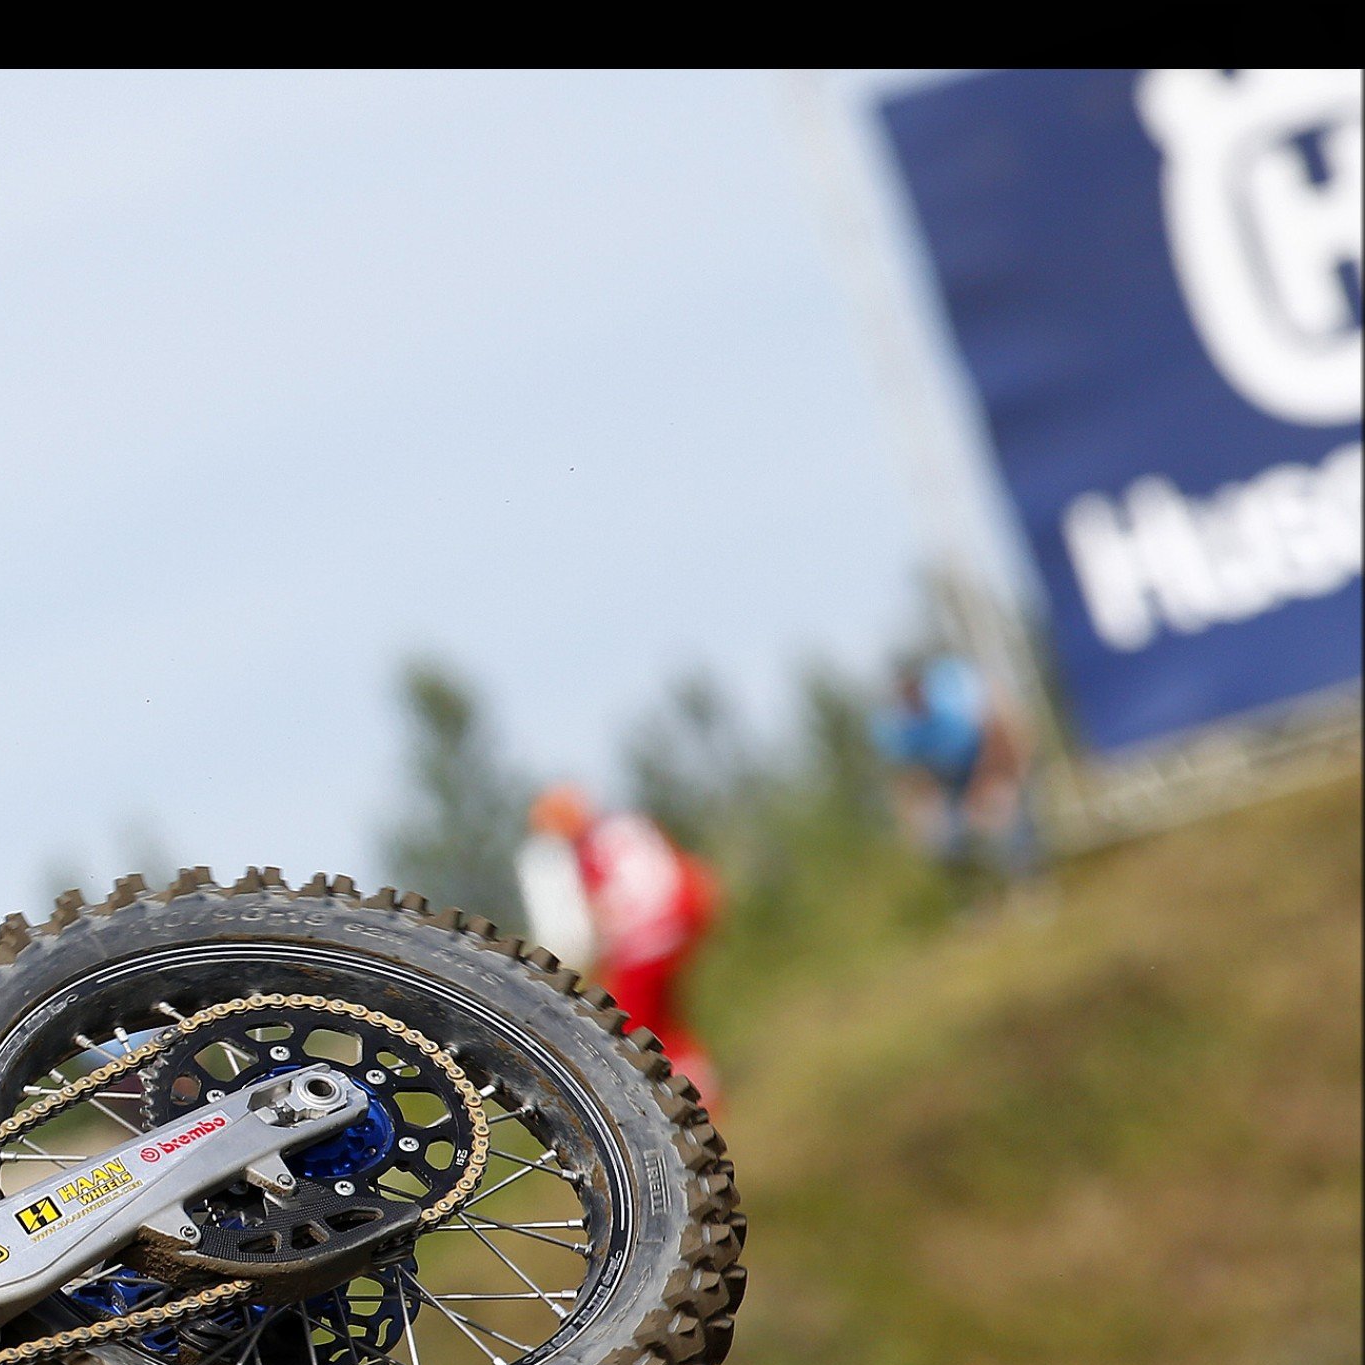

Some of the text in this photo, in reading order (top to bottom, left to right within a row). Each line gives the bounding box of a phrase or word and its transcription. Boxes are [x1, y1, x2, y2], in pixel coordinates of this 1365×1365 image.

[162, 1115, 226, 1155] brembo
[56, 1157, 127, 1204] HAAN
[76, 1171, 134, 1206] WHEELS
